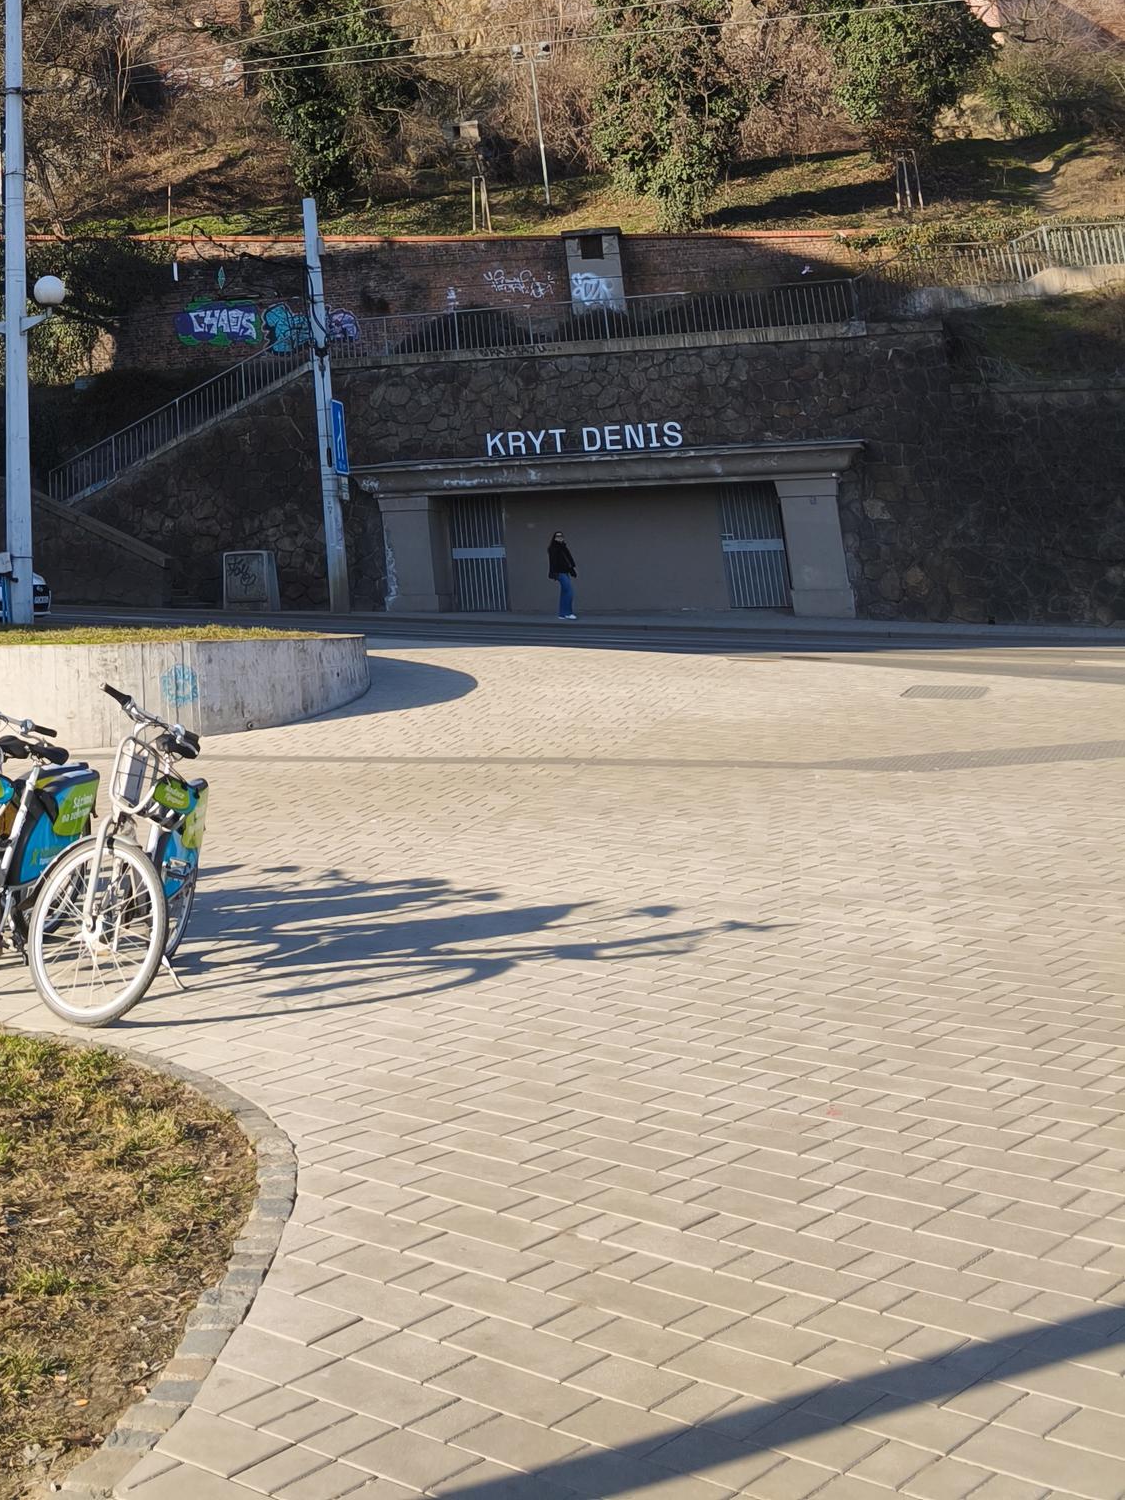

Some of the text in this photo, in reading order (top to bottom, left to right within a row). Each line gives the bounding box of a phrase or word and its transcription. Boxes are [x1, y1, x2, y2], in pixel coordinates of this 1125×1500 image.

[189, 308, 257, 340] CHAOS
[486, 421, 684, 457] KRYT DENIS
